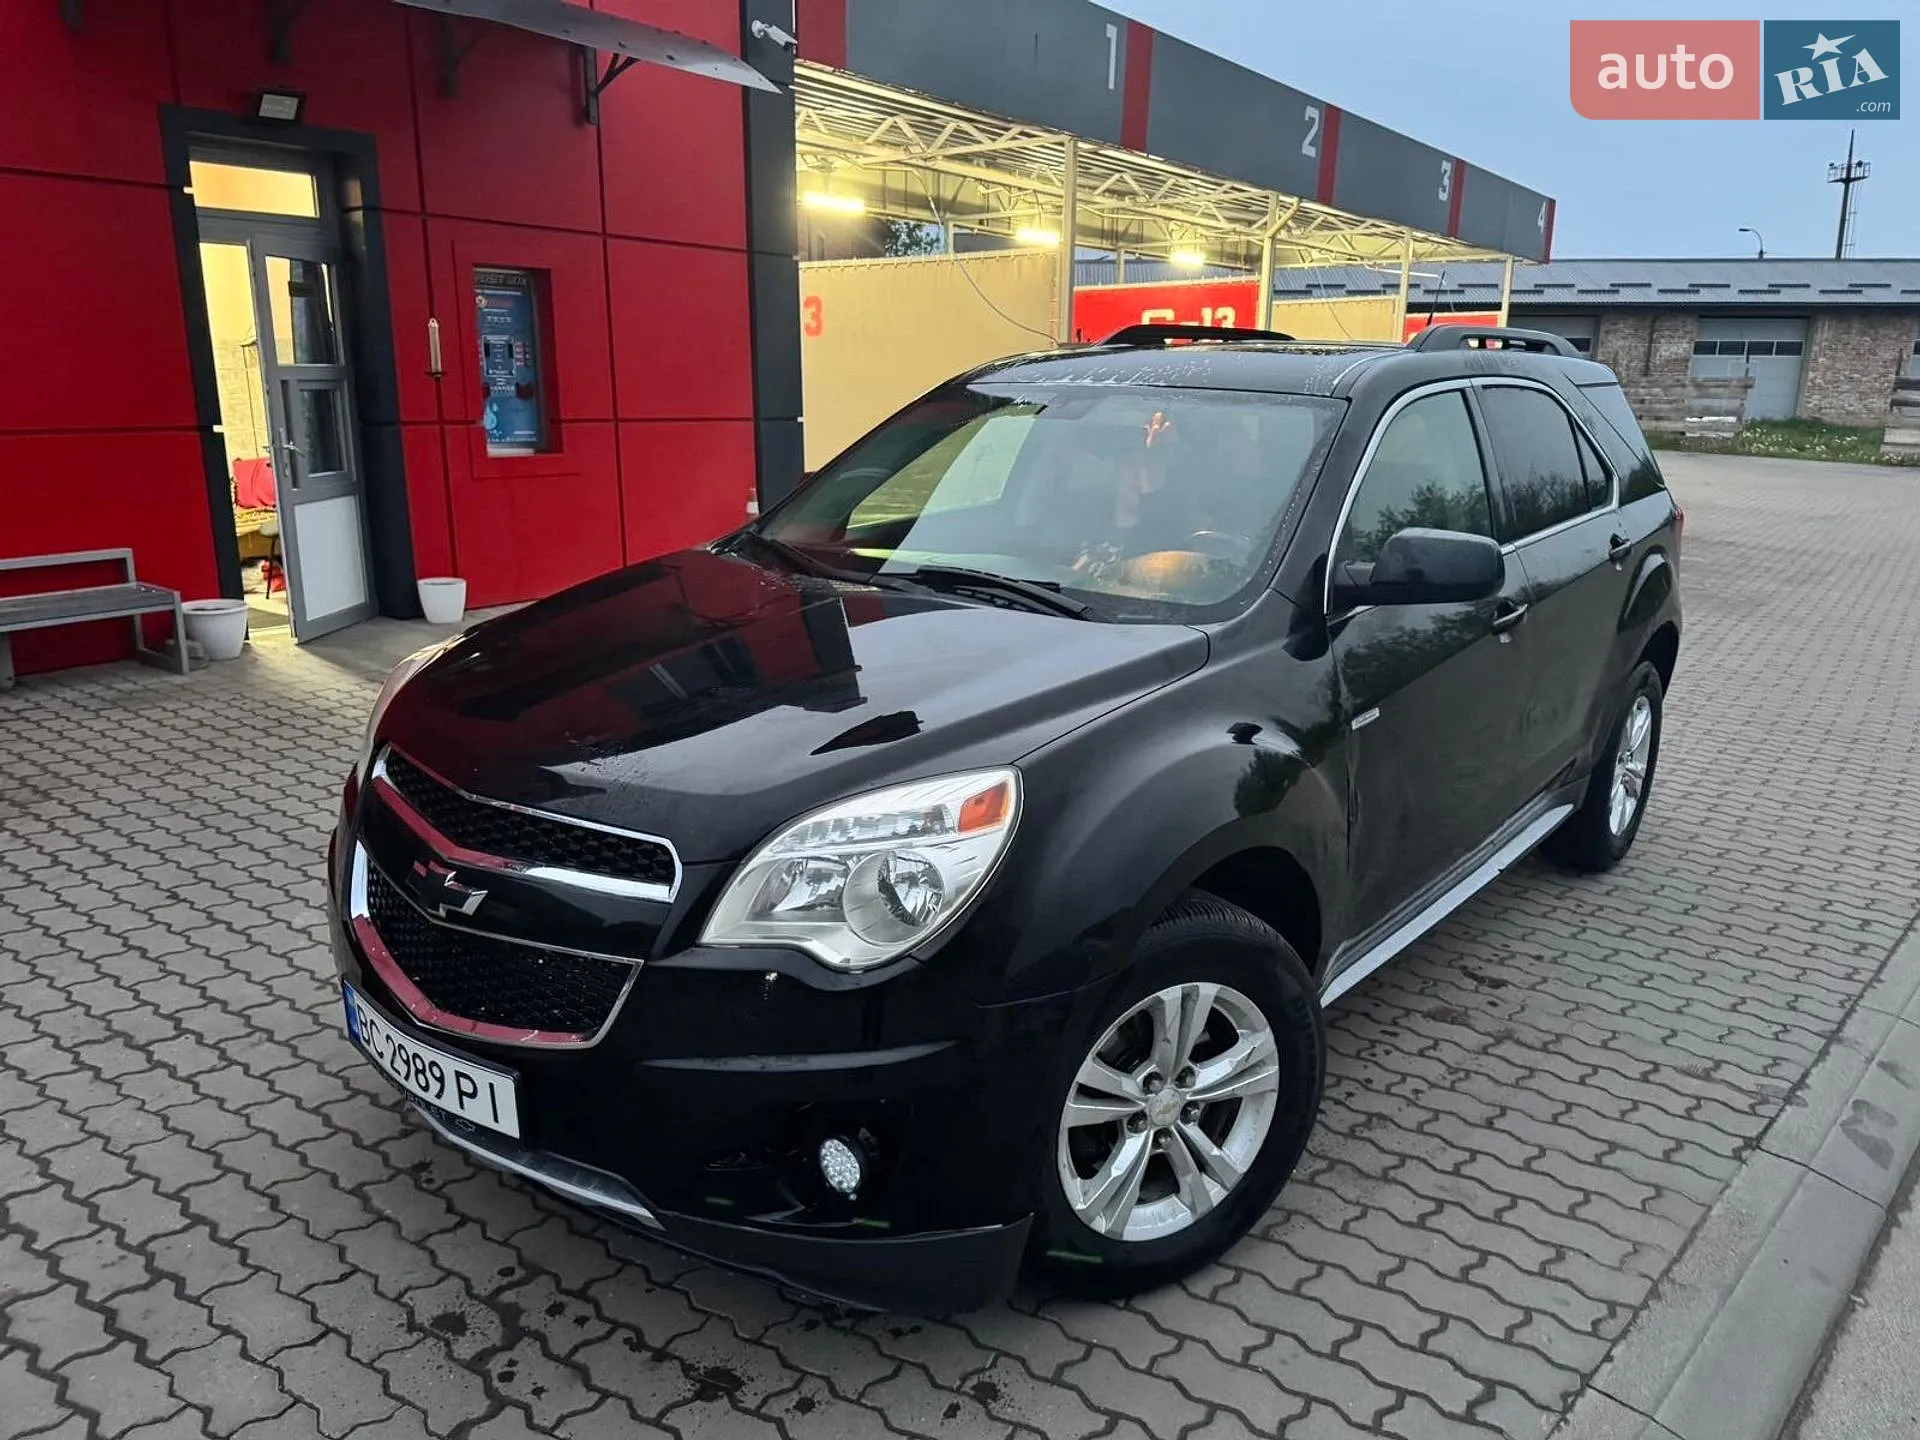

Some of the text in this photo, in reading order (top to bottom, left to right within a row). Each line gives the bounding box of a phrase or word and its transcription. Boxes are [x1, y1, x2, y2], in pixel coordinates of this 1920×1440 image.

[1106, 23, 1118, 90] 1
[1301, 105, 1320, 158] 2
[1438, 160, 1452, 202] 3
[1537, 201, 1546, 234] 4
[356, 1002, 384, 1060] BC
[385, 1033, 446, 1100] 2989
[454, 1069, 500, 1124] PI
